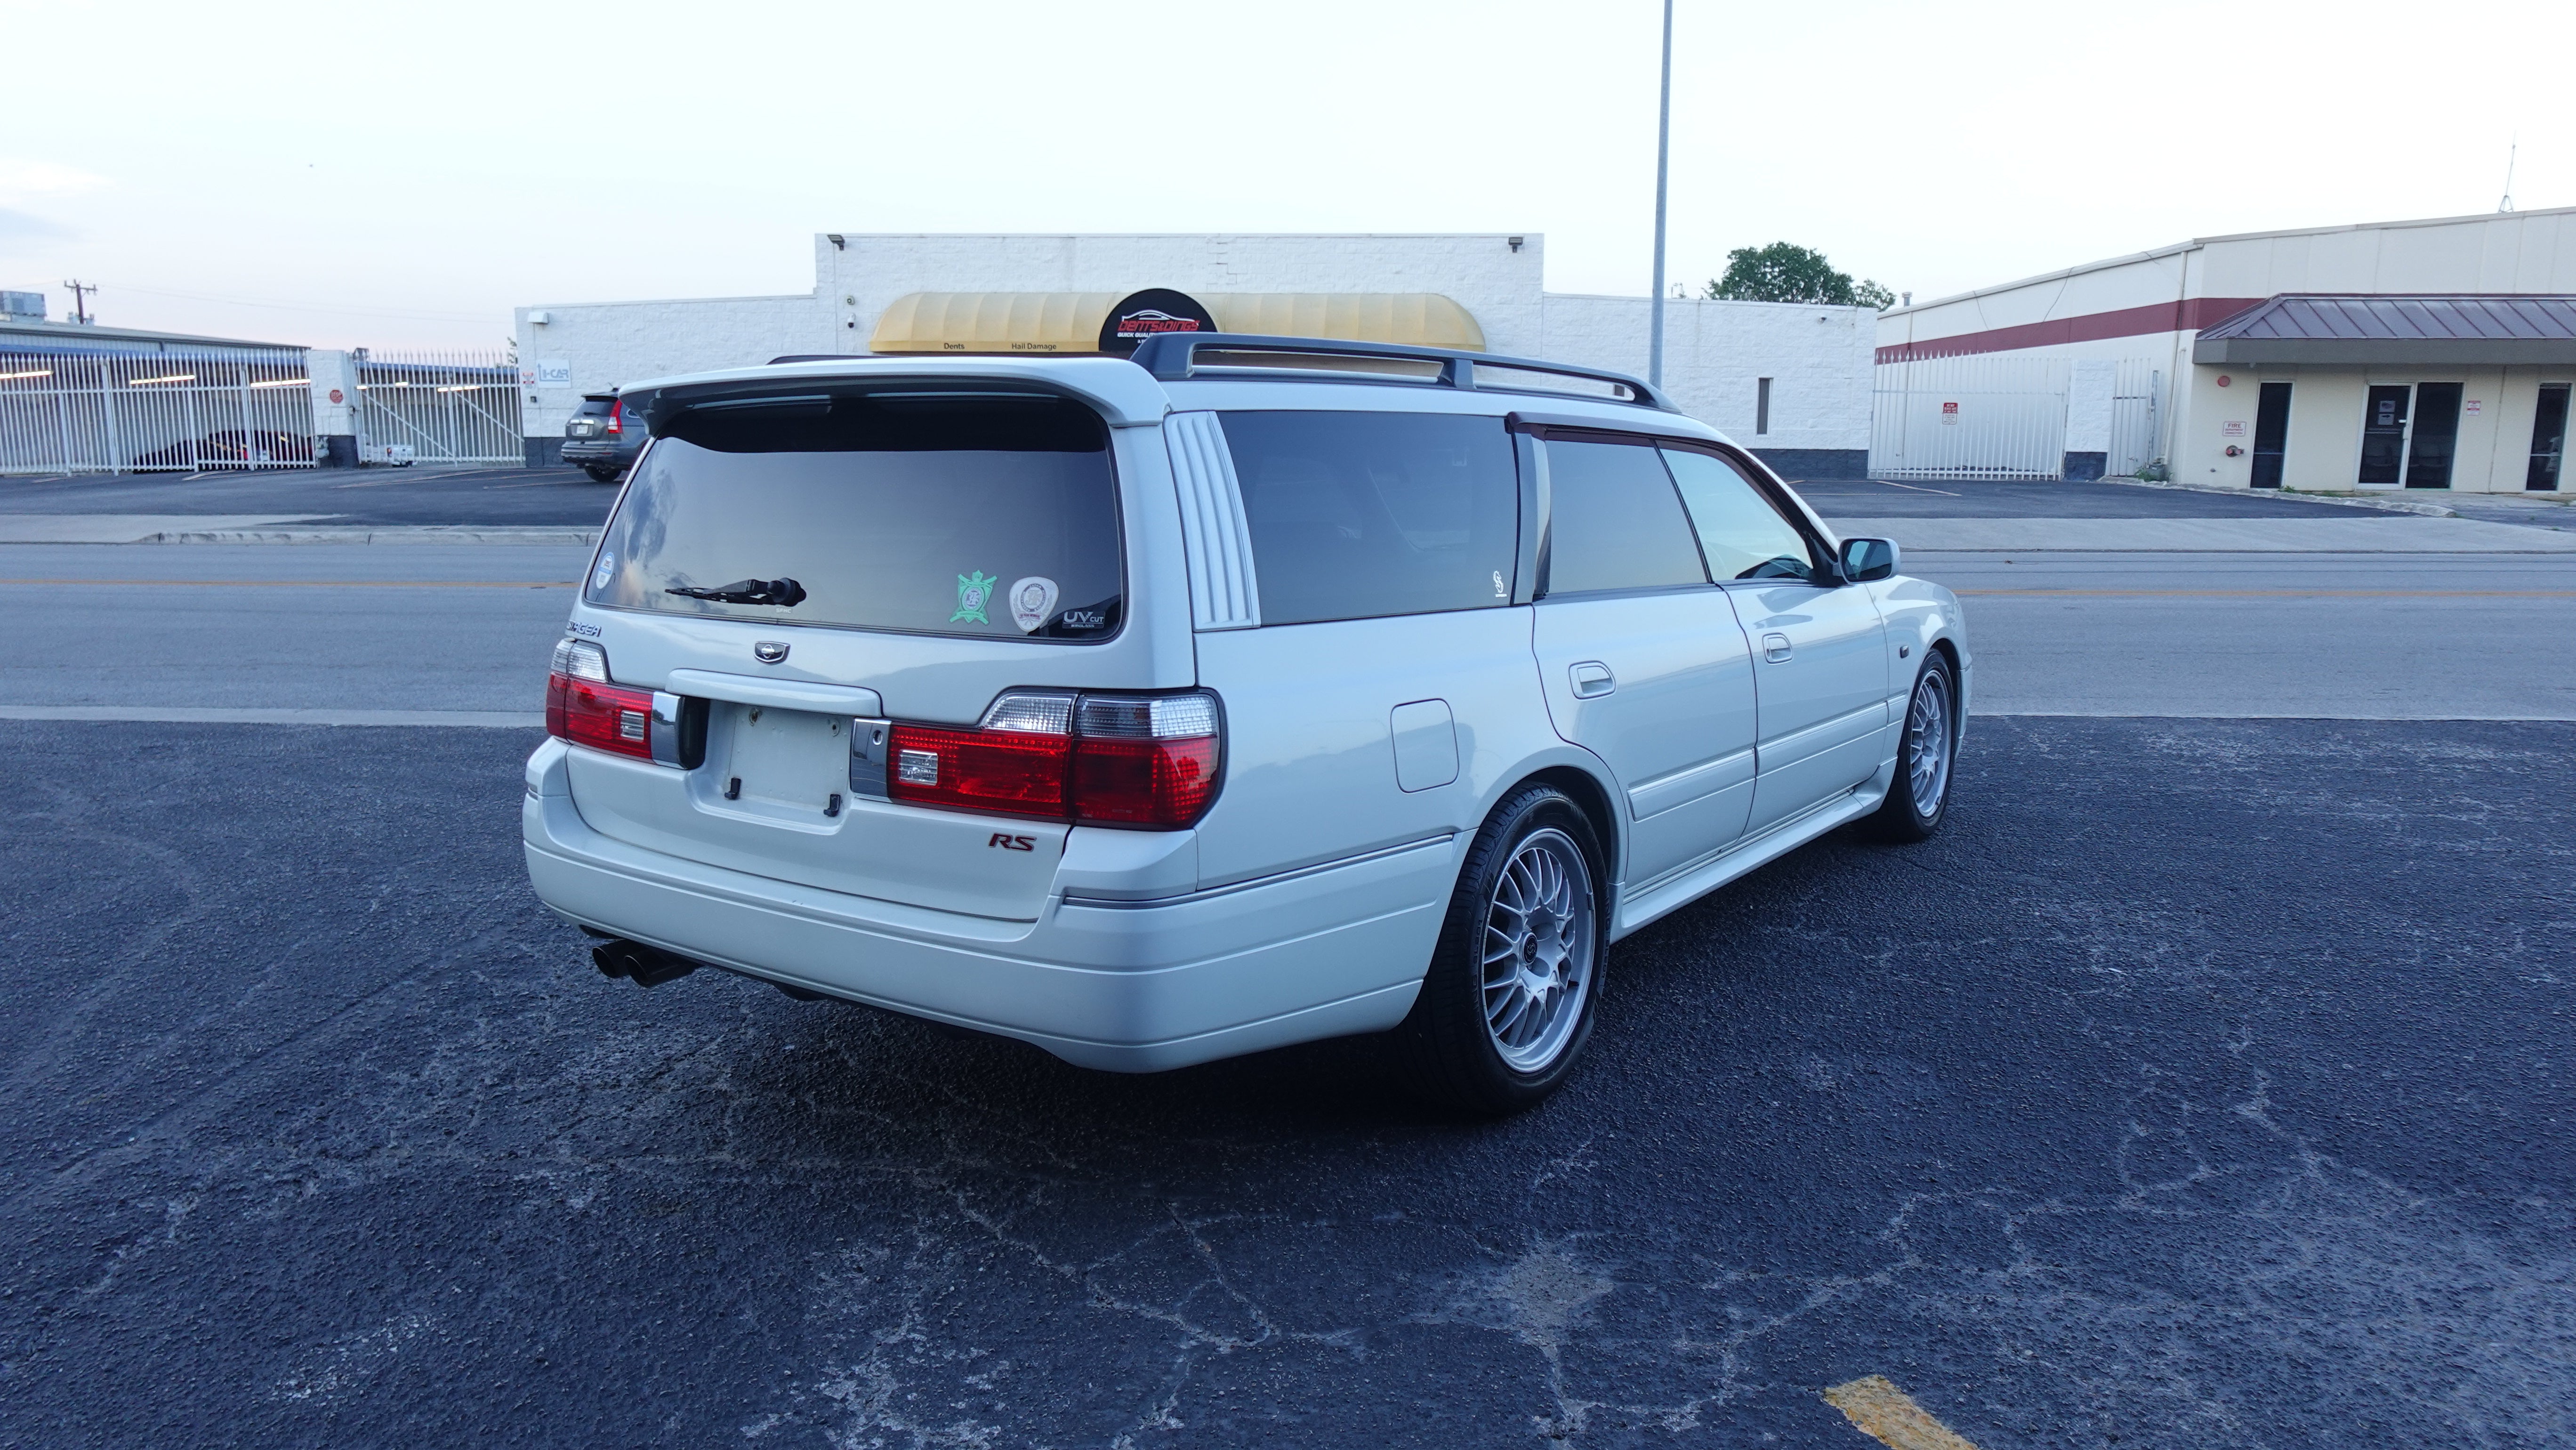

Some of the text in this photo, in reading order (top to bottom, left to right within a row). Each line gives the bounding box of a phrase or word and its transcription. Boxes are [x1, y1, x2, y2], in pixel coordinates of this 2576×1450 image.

[1027, 343, 1057, 351] Damage
[1064, 611, 1094, 623] UV
[988, 833, 1037, 853] RS
